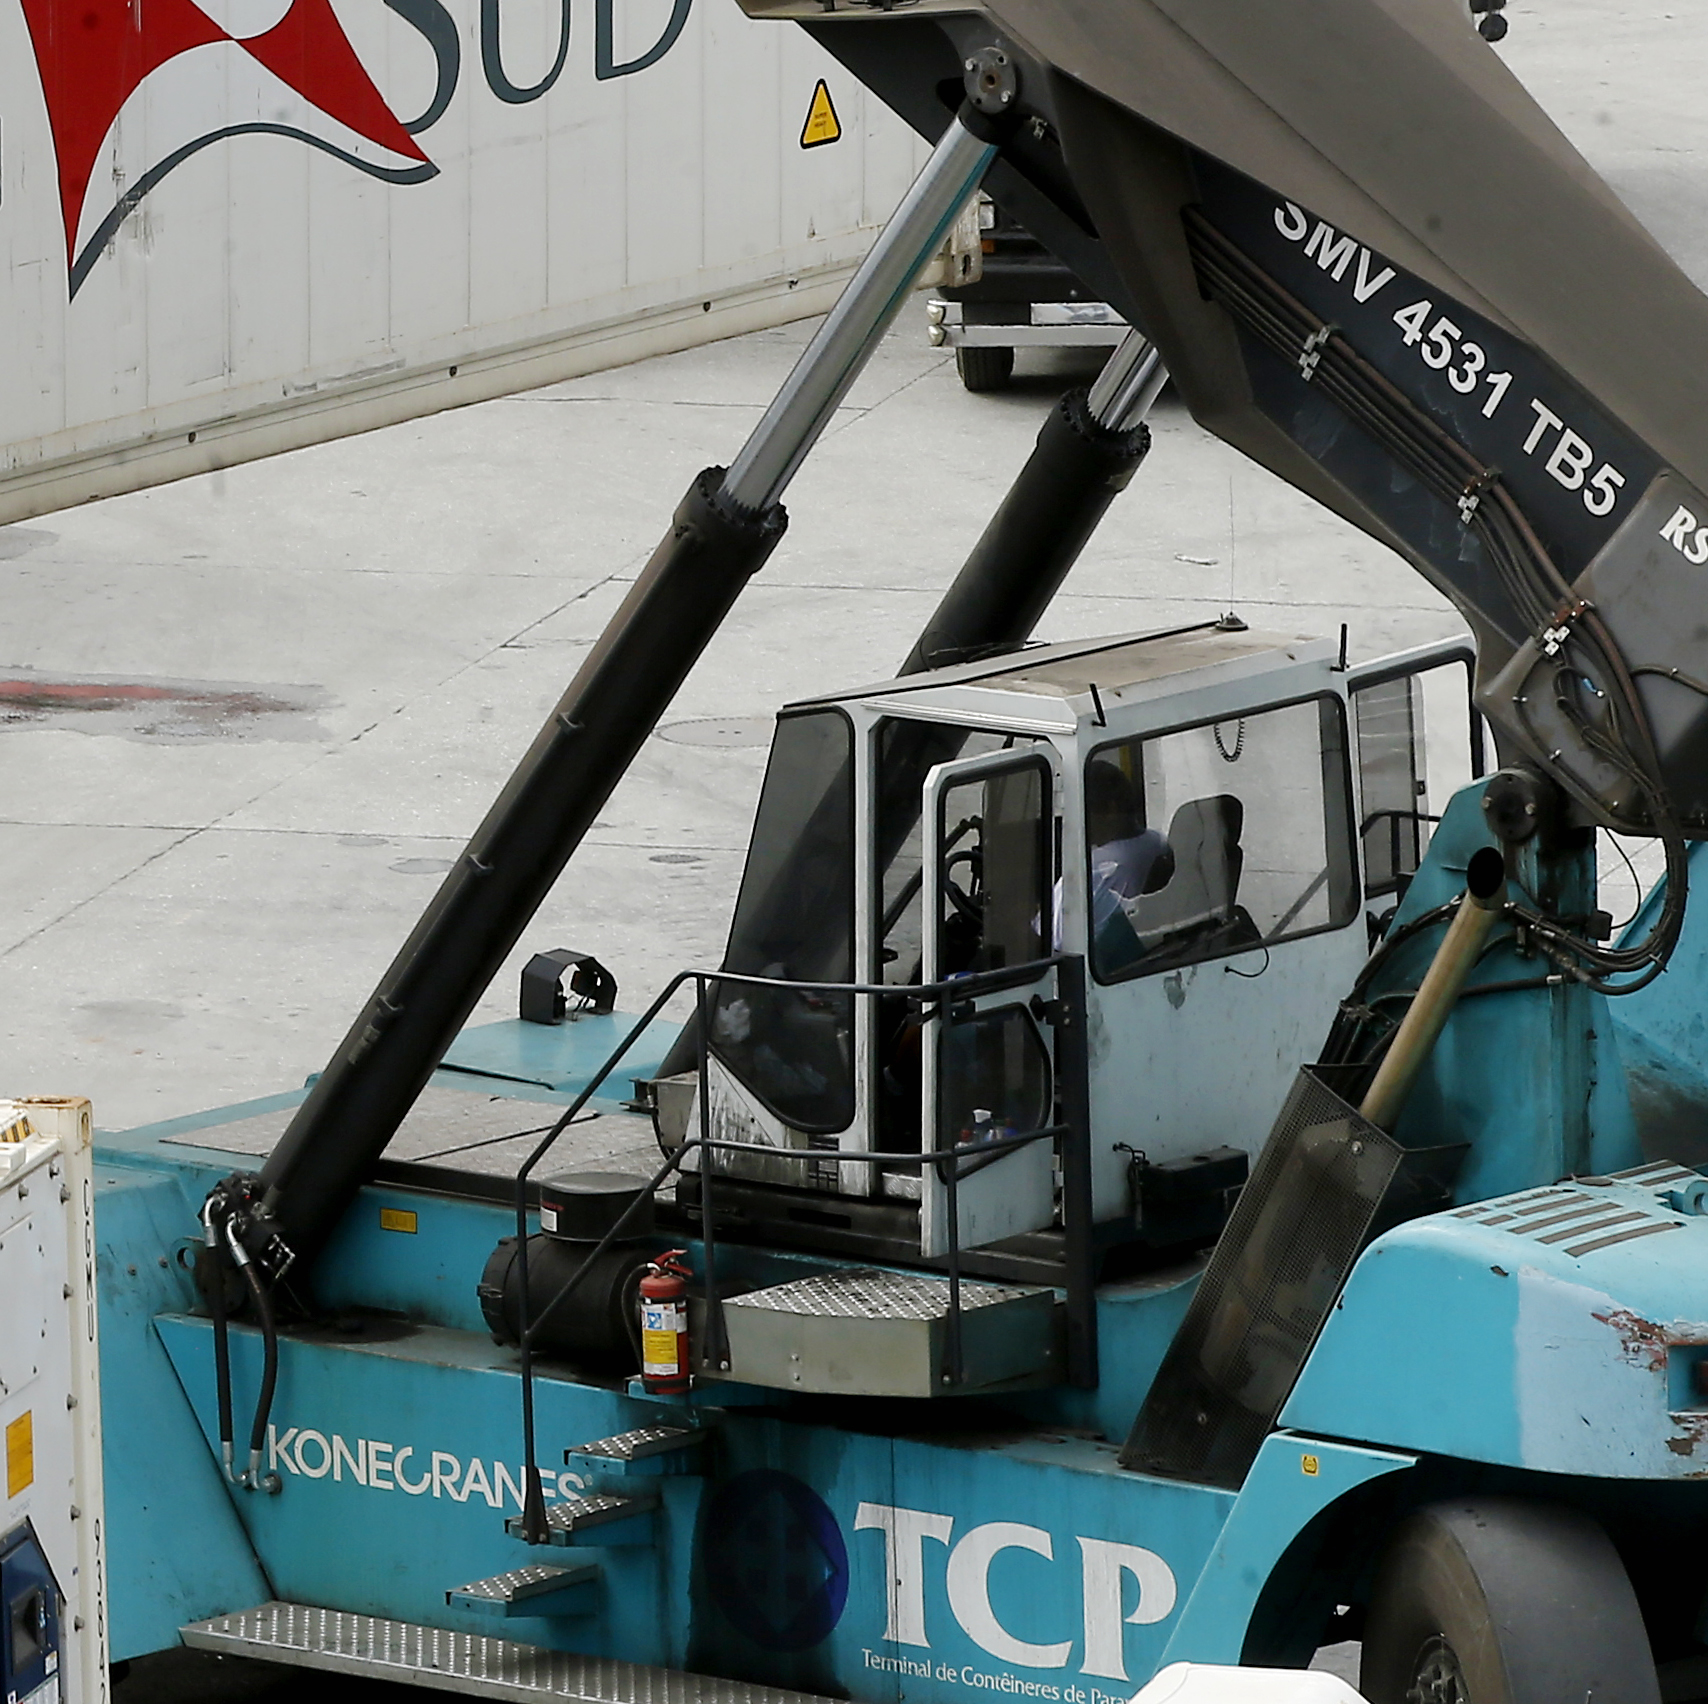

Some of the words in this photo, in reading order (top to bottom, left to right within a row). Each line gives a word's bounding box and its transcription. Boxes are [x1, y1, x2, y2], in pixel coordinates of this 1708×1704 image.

[1274, 201, 1396, 303] SMV
[1392, 299, 1514, 418] 4531
[1522, 398, 1627, 517] TB5
[853, 1500, 1178, 1682] TCP
[861, 1648, 932, 1678] Terminal
[935, 1661, 957, 1684] de
[961, 1665, 1060, 1701] Contêineres
[1064, 1684, 1085, 1704] de
